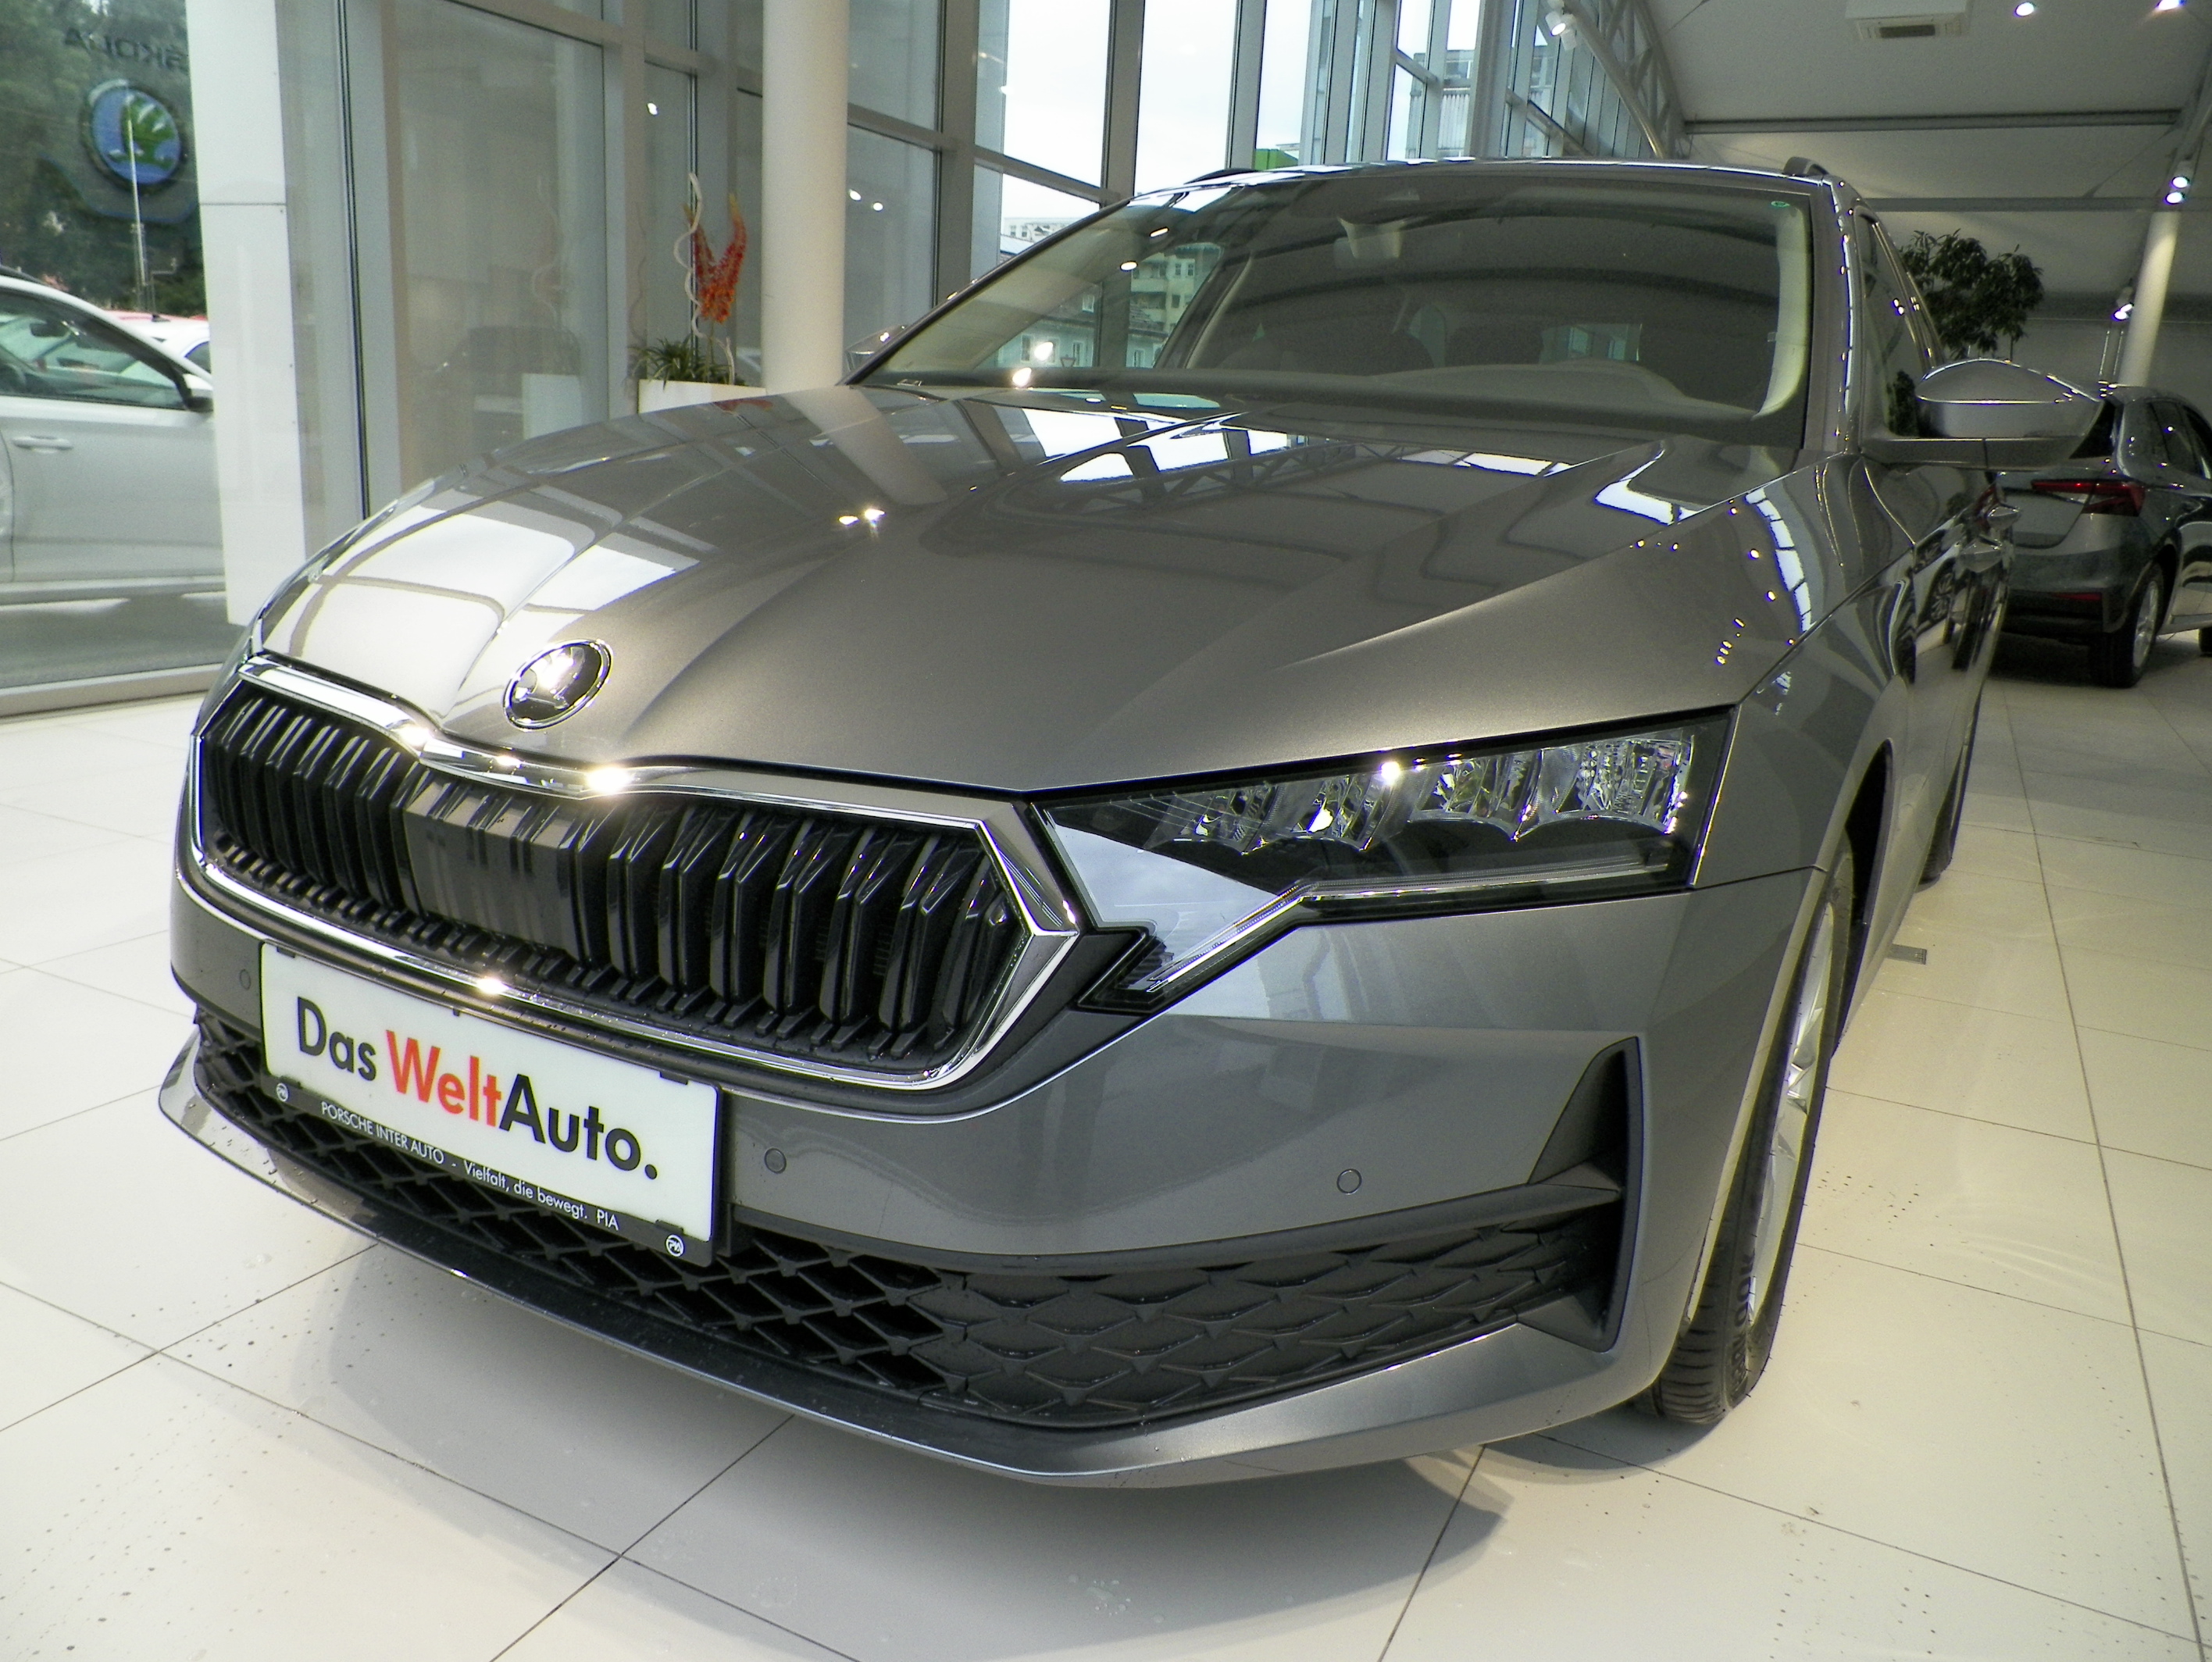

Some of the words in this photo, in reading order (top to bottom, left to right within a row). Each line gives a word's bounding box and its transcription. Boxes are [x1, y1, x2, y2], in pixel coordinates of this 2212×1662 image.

[297, 996, 376, 1082] Das
[386, 1029, 658, 1180] WeltAuto.
[321, 1100, 374, 1135] PORSCHE
[376, 1124, 412, 1150] INTER
[410, 1140, 445, 1164] AUTO
[463, 1159, 510, 1193] Vielfalt,
[513, 1179, 534, 1199] die
[536, 1186, 587, 1220] bewegt.
[596, 1208, 619, 1231] PIA
